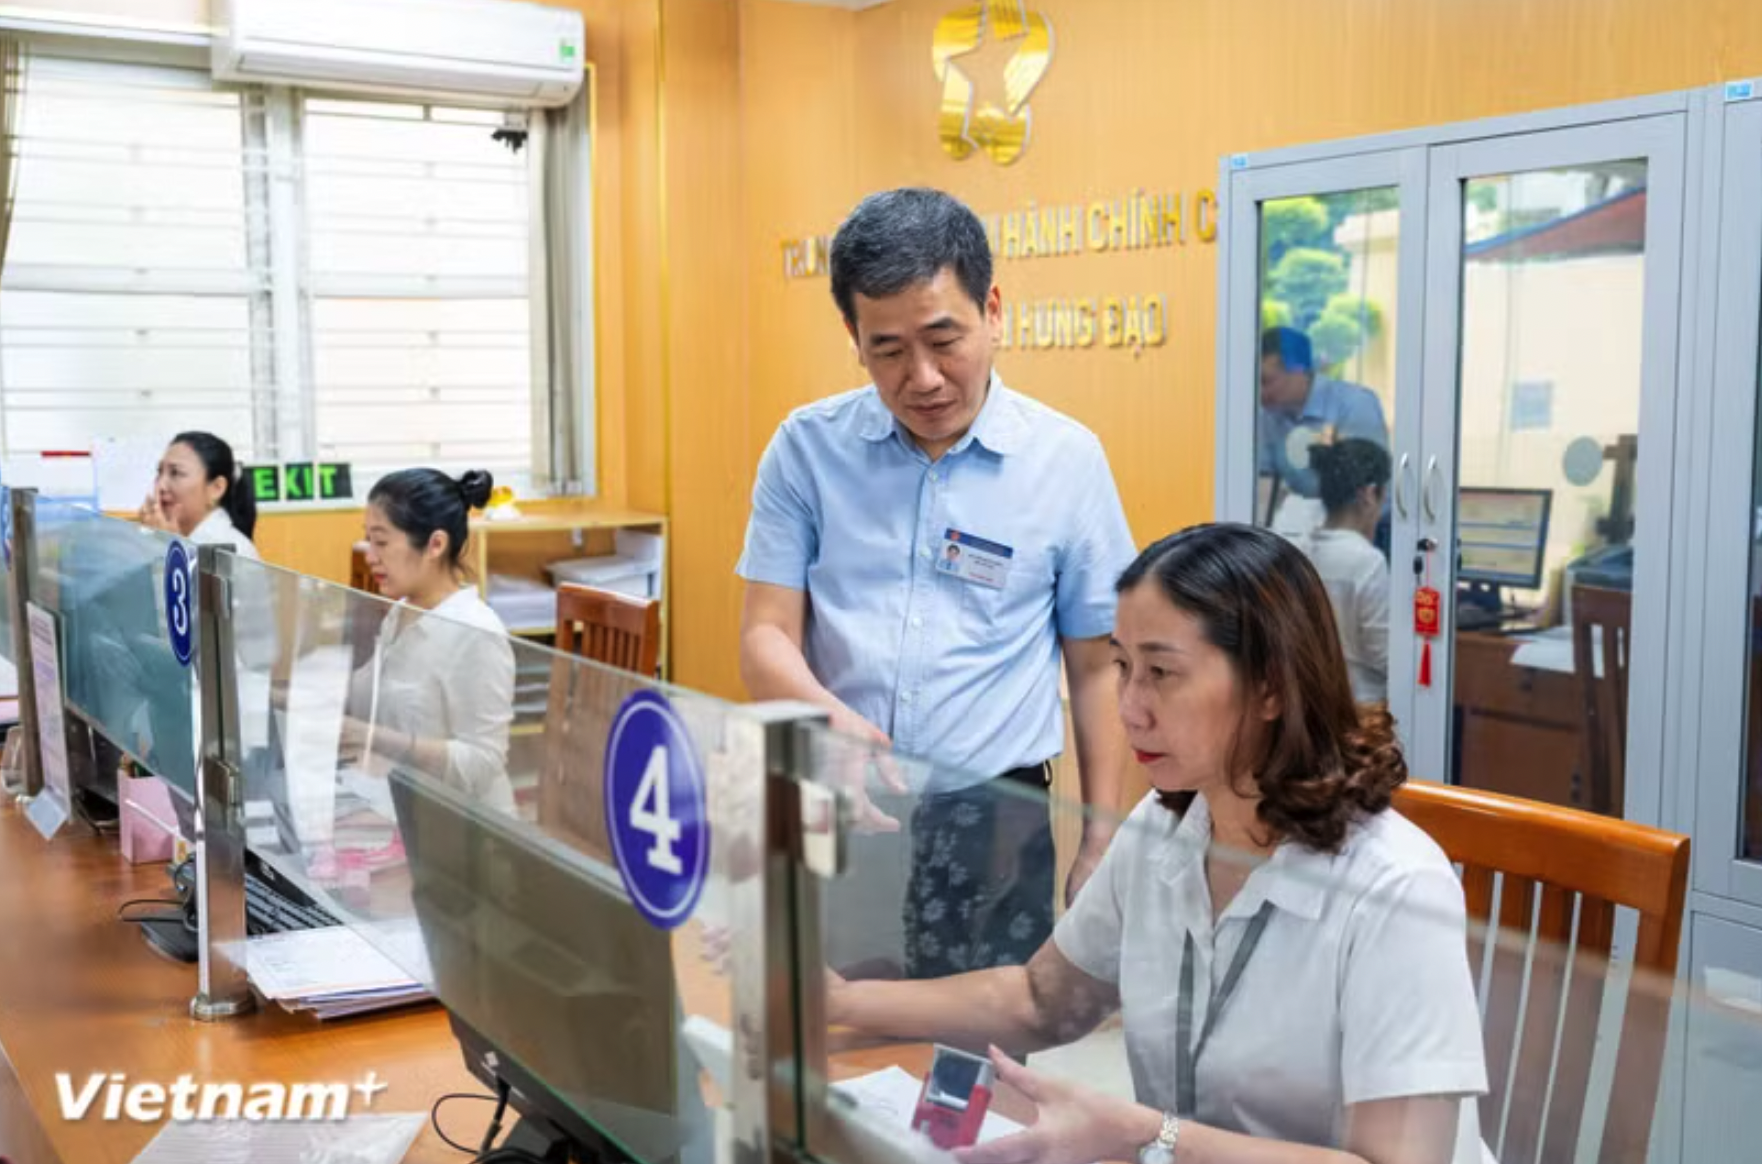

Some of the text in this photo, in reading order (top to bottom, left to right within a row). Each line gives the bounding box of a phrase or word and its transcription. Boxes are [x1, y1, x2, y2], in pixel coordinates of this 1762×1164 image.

[779, 236, 832, 277] TRUN
[1003, 194, 1082, 259] HÀNH
[1088, 187, 1186, 252] CHÍNH
[1103, 293, 1167, 359] ĐẠO
[173, 567, 188, 636] 3
[630, 745, 683, 875] 4
